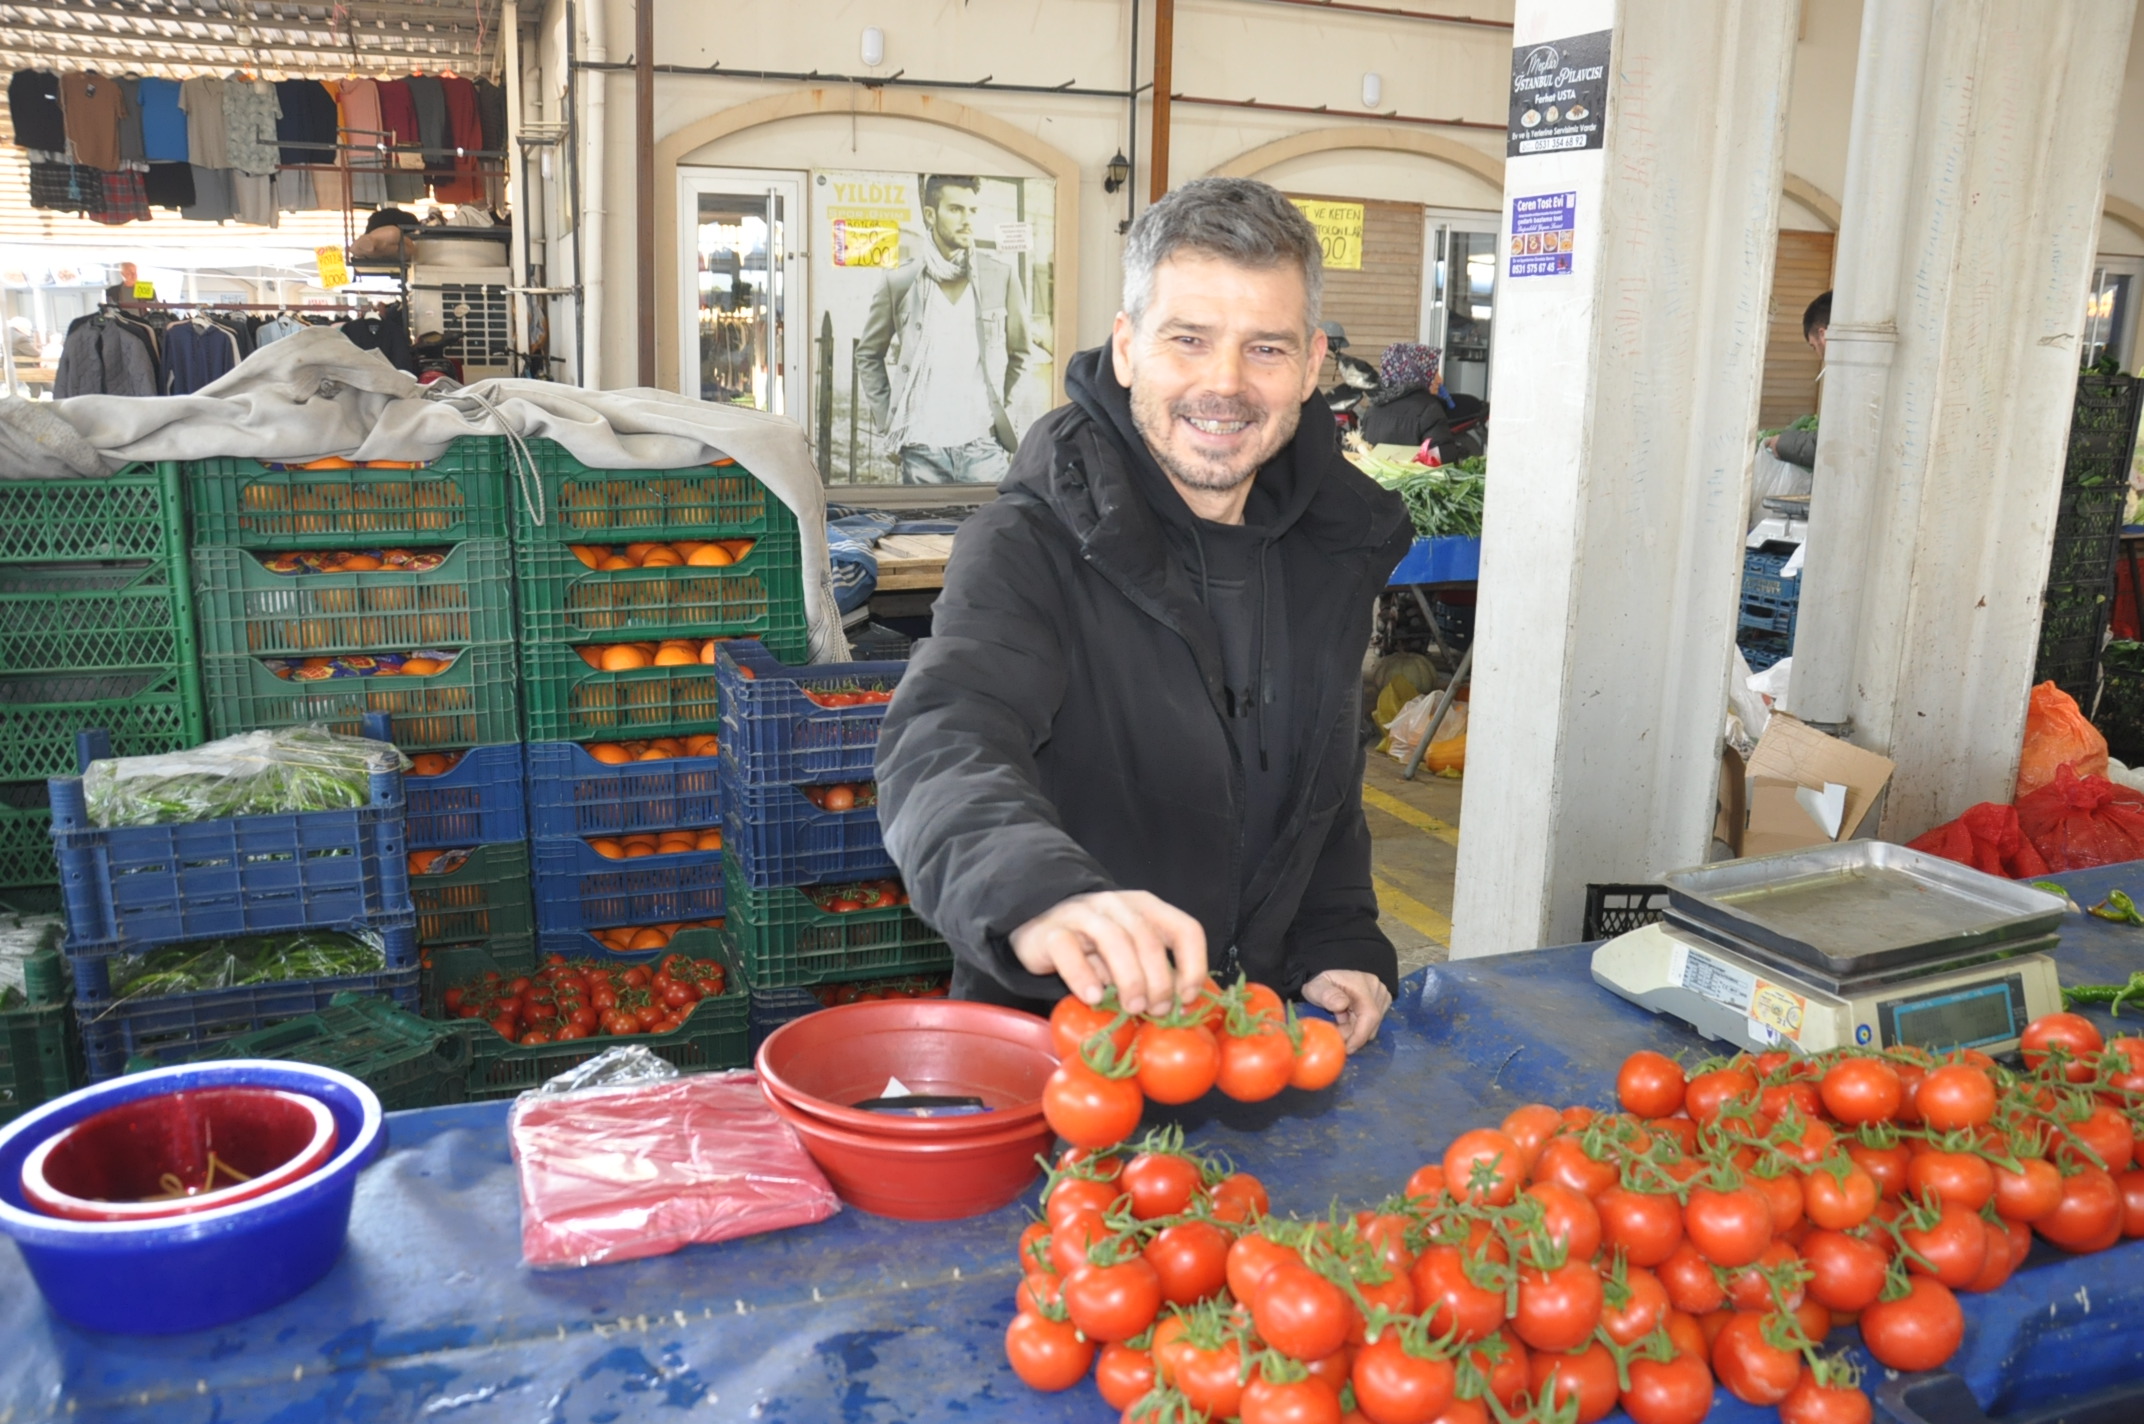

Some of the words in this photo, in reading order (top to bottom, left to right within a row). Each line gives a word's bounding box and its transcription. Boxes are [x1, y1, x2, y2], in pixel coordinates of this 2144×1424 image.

[1535, 93, 1556, 104] Ferhat
[1557, 89, 1576, 101] USTA
[1535, 139, 1550, 150] 0531
[1552, 138, 1563, 148] 354
[1575, 136, 1584, 145] 92
[833, 183, 906, 204] YILDIZ
[1517, 200, 1536, 212] Ceren
[1537, 197, 1552, 209] Tost
[1553, 194, 1564, 208] Evi
[1314, 208, 1326, 218] VE
[1329, 208, 1360, 220] KETEN
[1512, 264, 1526, 274] 0531
[1527, 263, 1537, 273] 575
[1538, 262, 1546, 273] 67
[1547, 262, 1555, 272] 45
